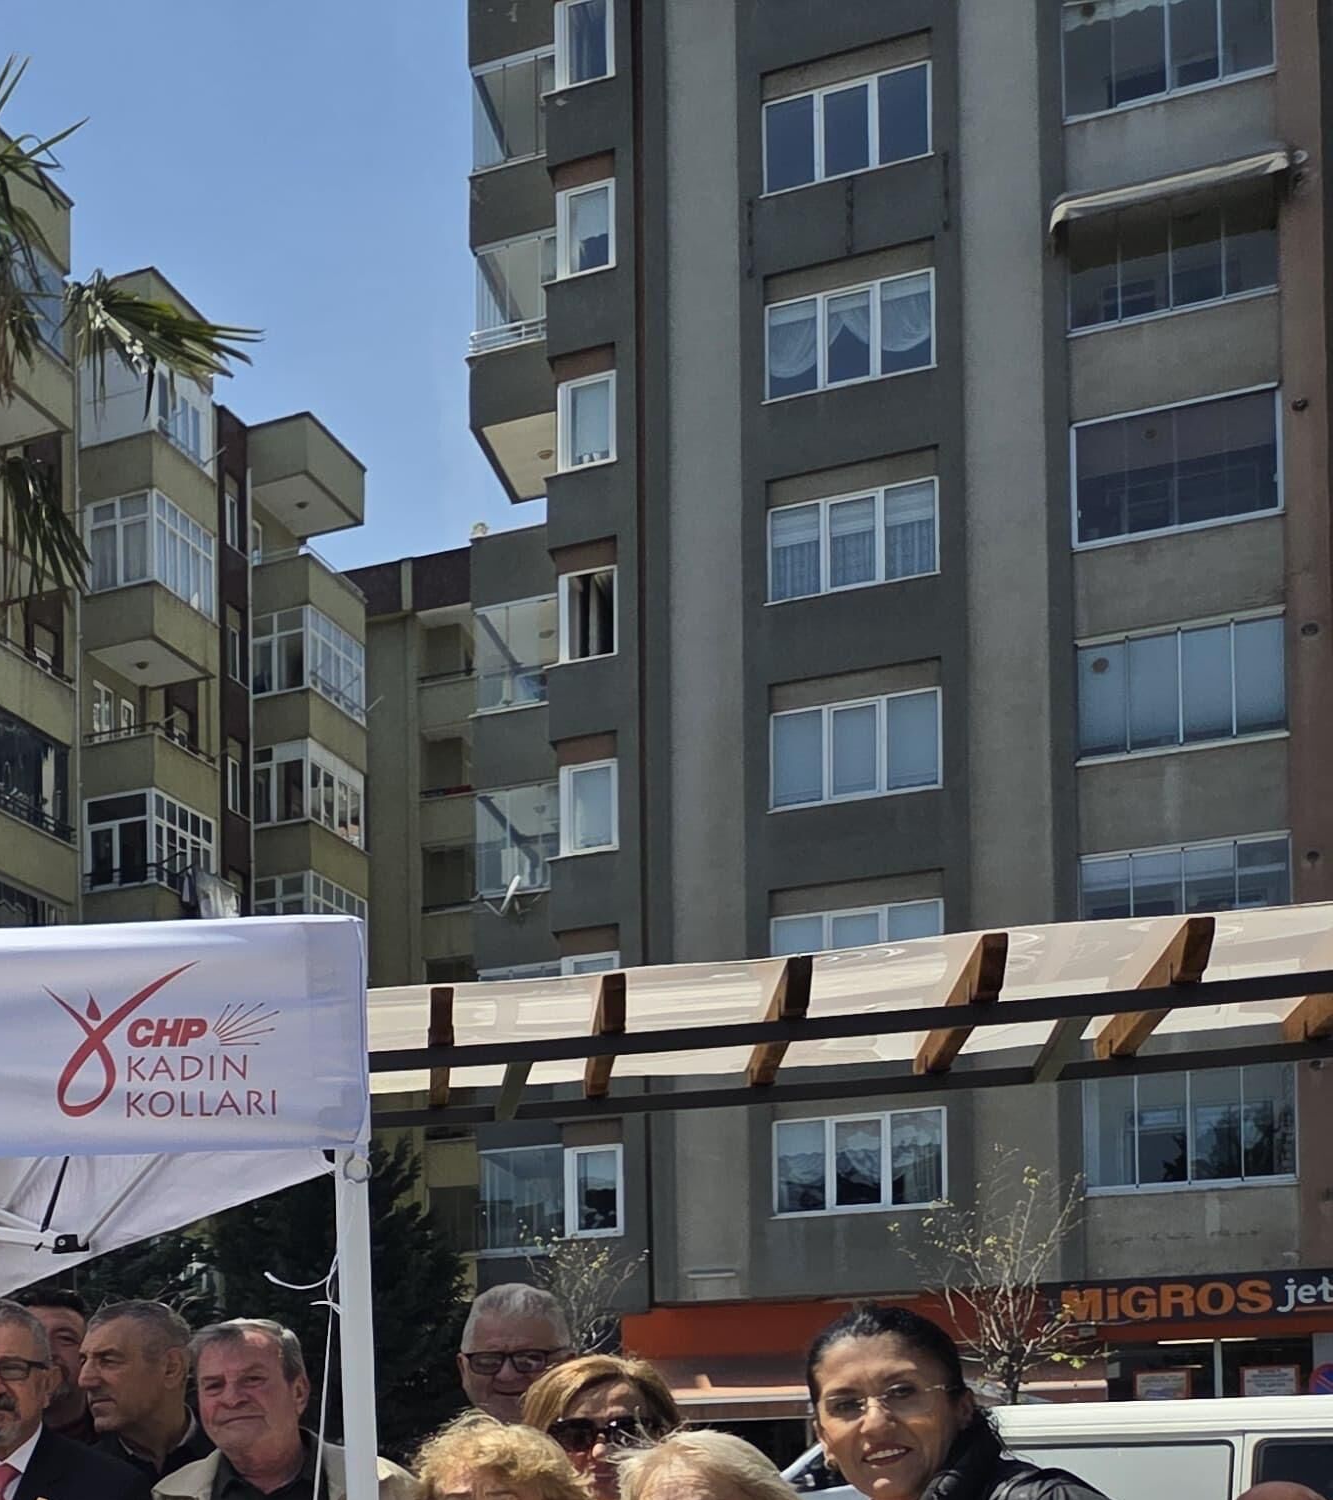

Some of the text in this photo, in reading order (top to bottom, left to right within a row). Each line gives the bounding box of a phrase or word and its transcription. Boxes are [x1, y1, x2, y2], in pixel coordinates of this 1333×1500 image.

[126, 1018, 209, 1048] CHP
[126, 1053, 248, 1082] KADIN
[125, 1089, 278, 1119] KOLLARI
